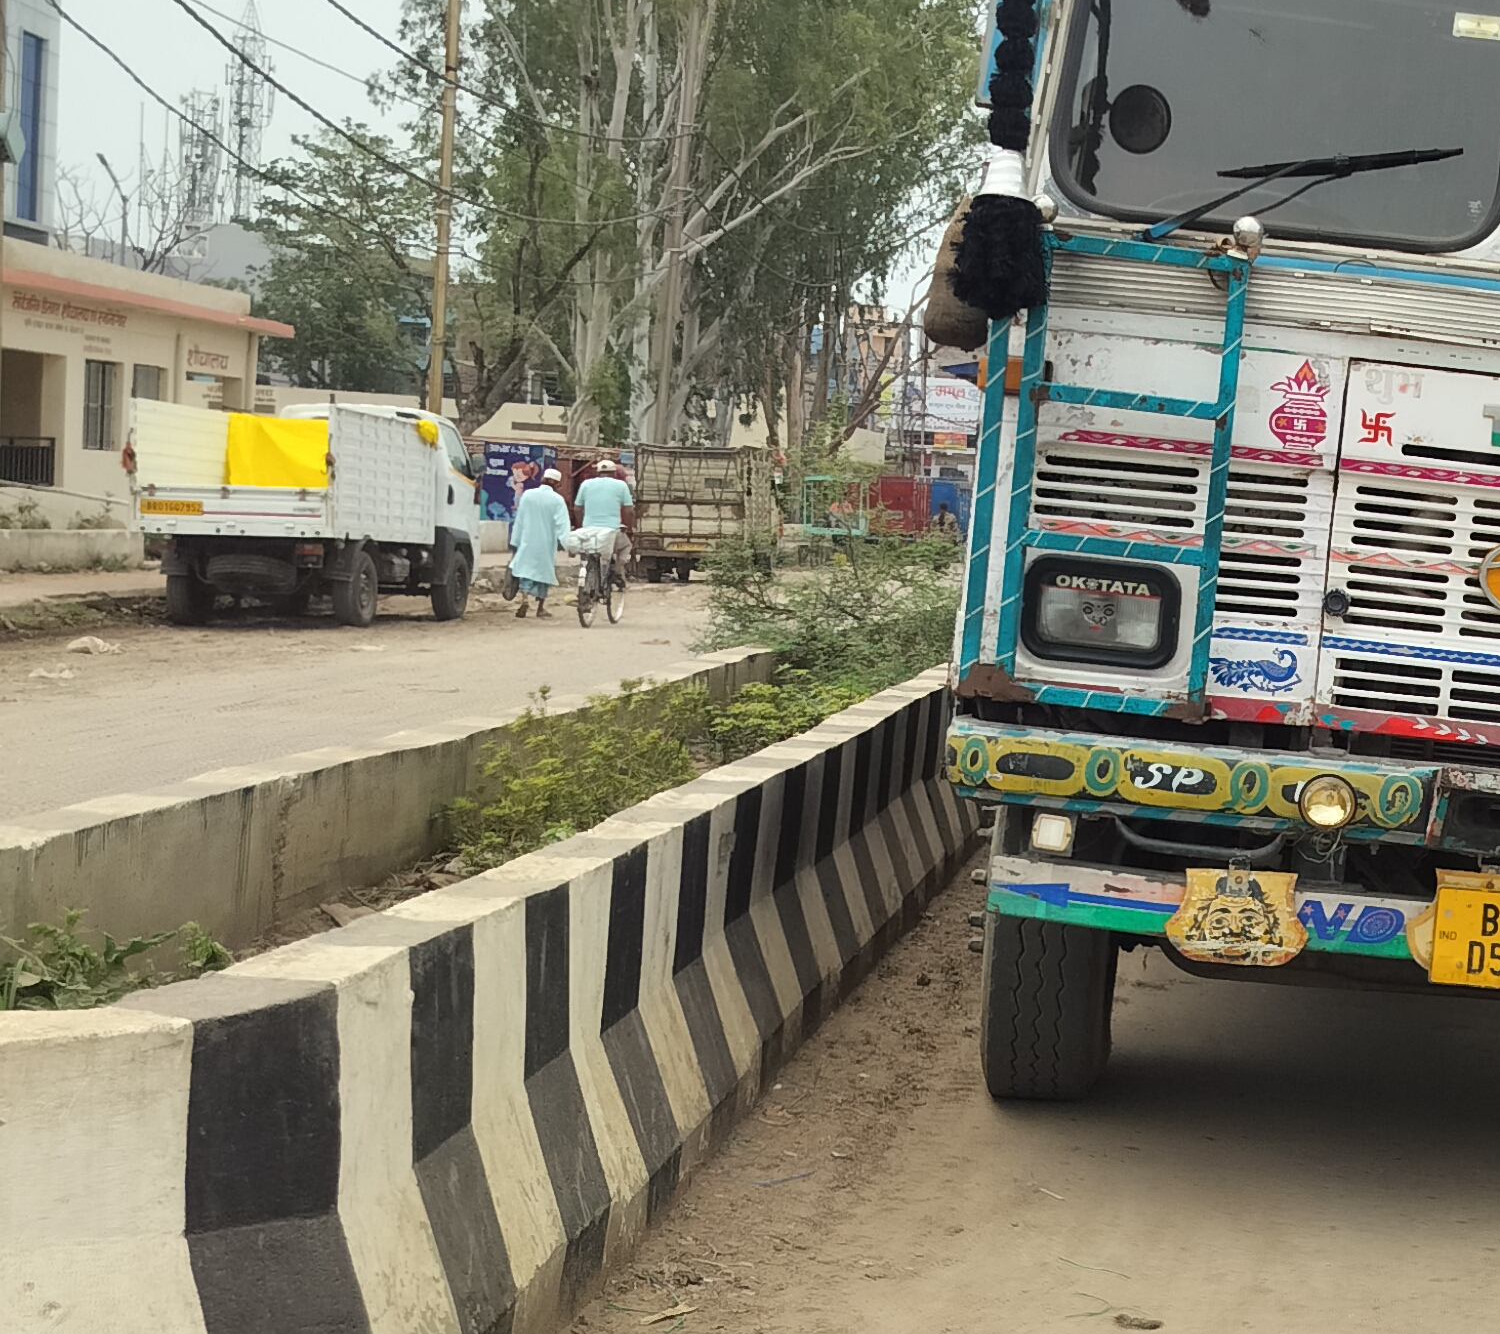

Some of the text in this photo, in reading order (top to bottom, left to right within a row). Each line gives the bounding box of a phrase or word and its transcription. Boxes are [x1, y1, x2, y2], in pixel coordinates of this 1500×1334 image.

[1099, 579, 1150, 596] TATA
[1134, 763, 1204, 793] SP
[1438, 929, 1458, 941] IND
